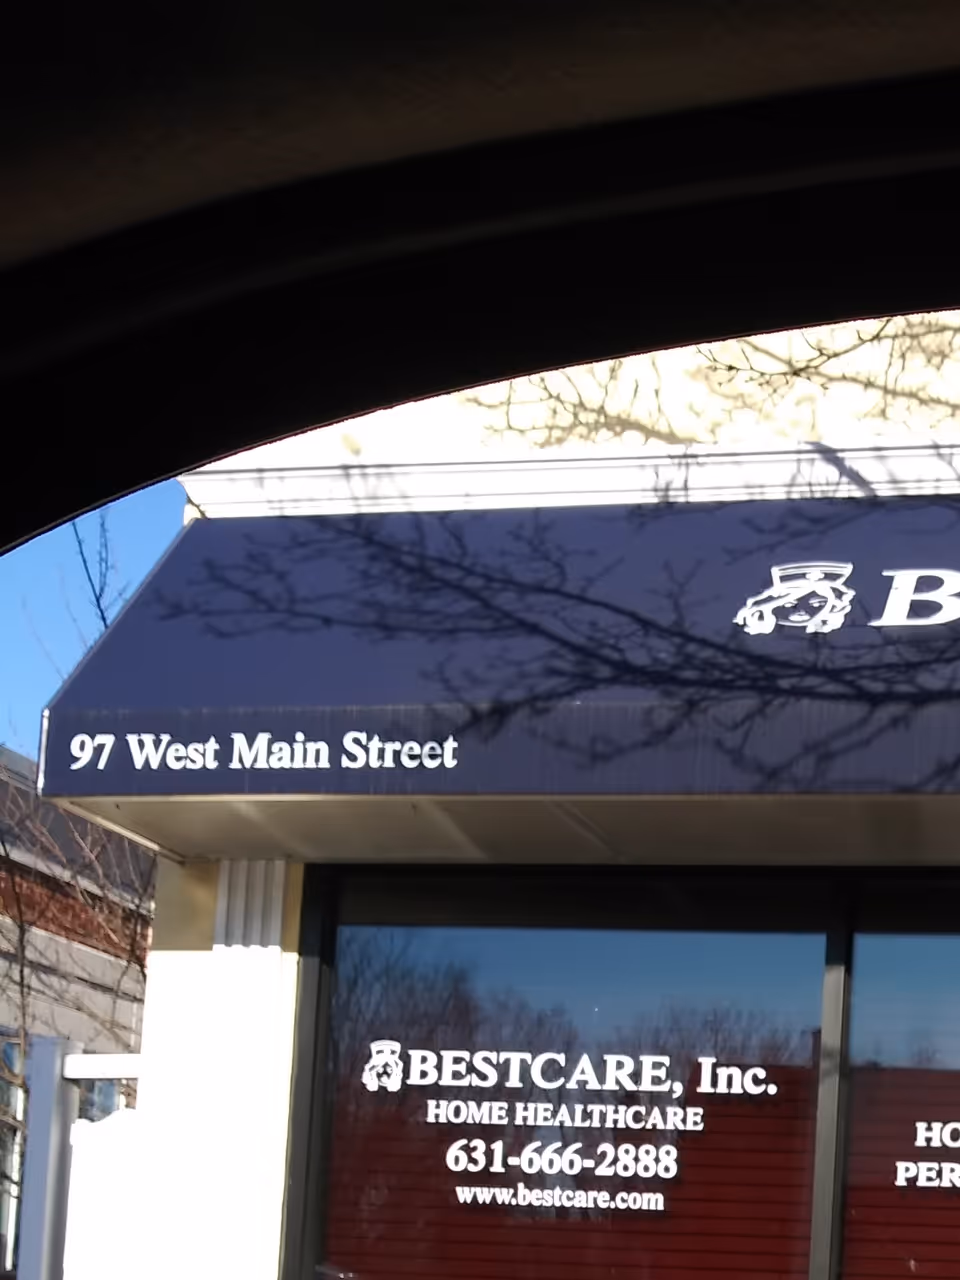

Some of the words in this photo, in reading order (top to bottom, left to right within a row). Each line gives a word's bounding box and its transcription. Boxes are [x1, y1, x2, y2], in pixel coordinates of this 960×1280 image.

[69, 733, 116, 770] 97
[125, 733, 221, 770] West
[228, 731, 331, 769] Main
[340, 730, 459, 769] Street
[406, 1049, 684, 1098] BESTCARE,
[696, 1055, 778, 1096] Inc.
[426, 1099, 509, 1125] HOME
[513, 1101, 705, 1131] HEALTHCARE
[445, 1138, 678, 1179] 631-666-2888
[455, 1181, 665, 1211] www.bestcare.com
